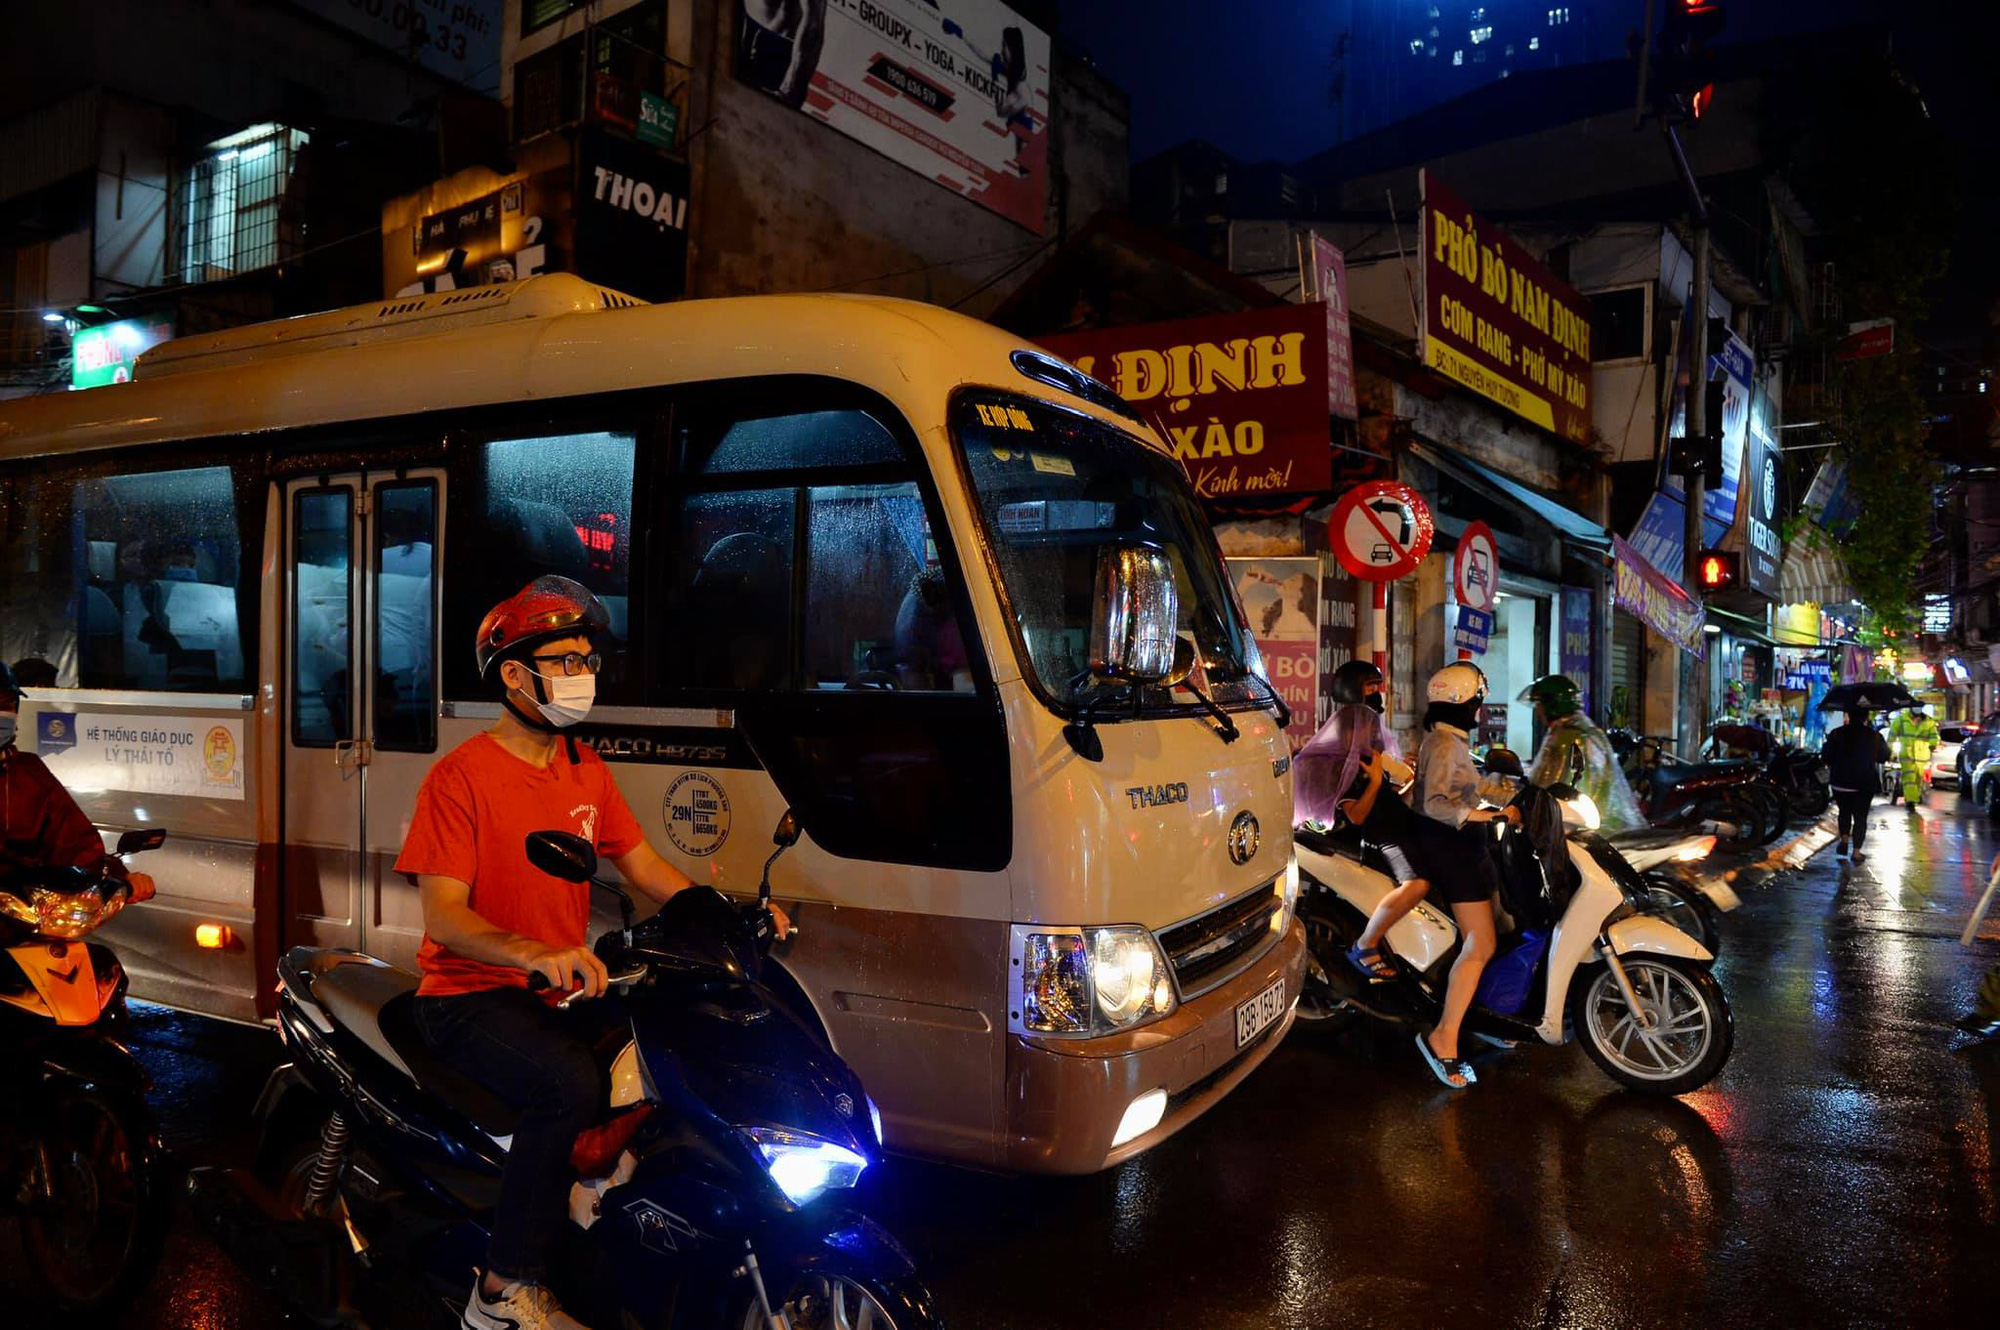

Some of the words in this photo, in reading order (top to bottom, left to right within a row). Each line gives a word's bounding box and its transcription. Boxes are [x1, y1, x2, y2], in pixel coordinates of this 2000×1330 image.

[859, 1, 912, 48] GROUPX
[925, 40, 955, 76] YOGA
[594, 165, 688, 234] THOẠI
[1433, 208, 1478, 284] PHỞ
[1480, 242, 1508, 305] BÒ
[1510, 266, 1550, 336] NAM
[1552, 297, 1591, 364] ĐỊNH
[1440, 293, 1474, 344] CƠM
[1476, 316, 1512, 368] RANG
[1522, 344, 1546, 387] PHỞ
[1111, 332, 1306, 413] ĐỊNH
[1169, 416, 1264, 461] XÀO
[1276, 653, 1315, 678] BÒ
[86, 726, 100, 744] HỆ
[102, 725, 138, 743] THỐNG
[140, 727, 167, 745] GIÁO
[170, 732, 194, 747] DỤC
[104, 744, 120, 763] LÝ
[123, 745, 154, 765] THÁI
[672, 805, 692, 821] 29N
[1125, 782, 1189, 810] THACO
